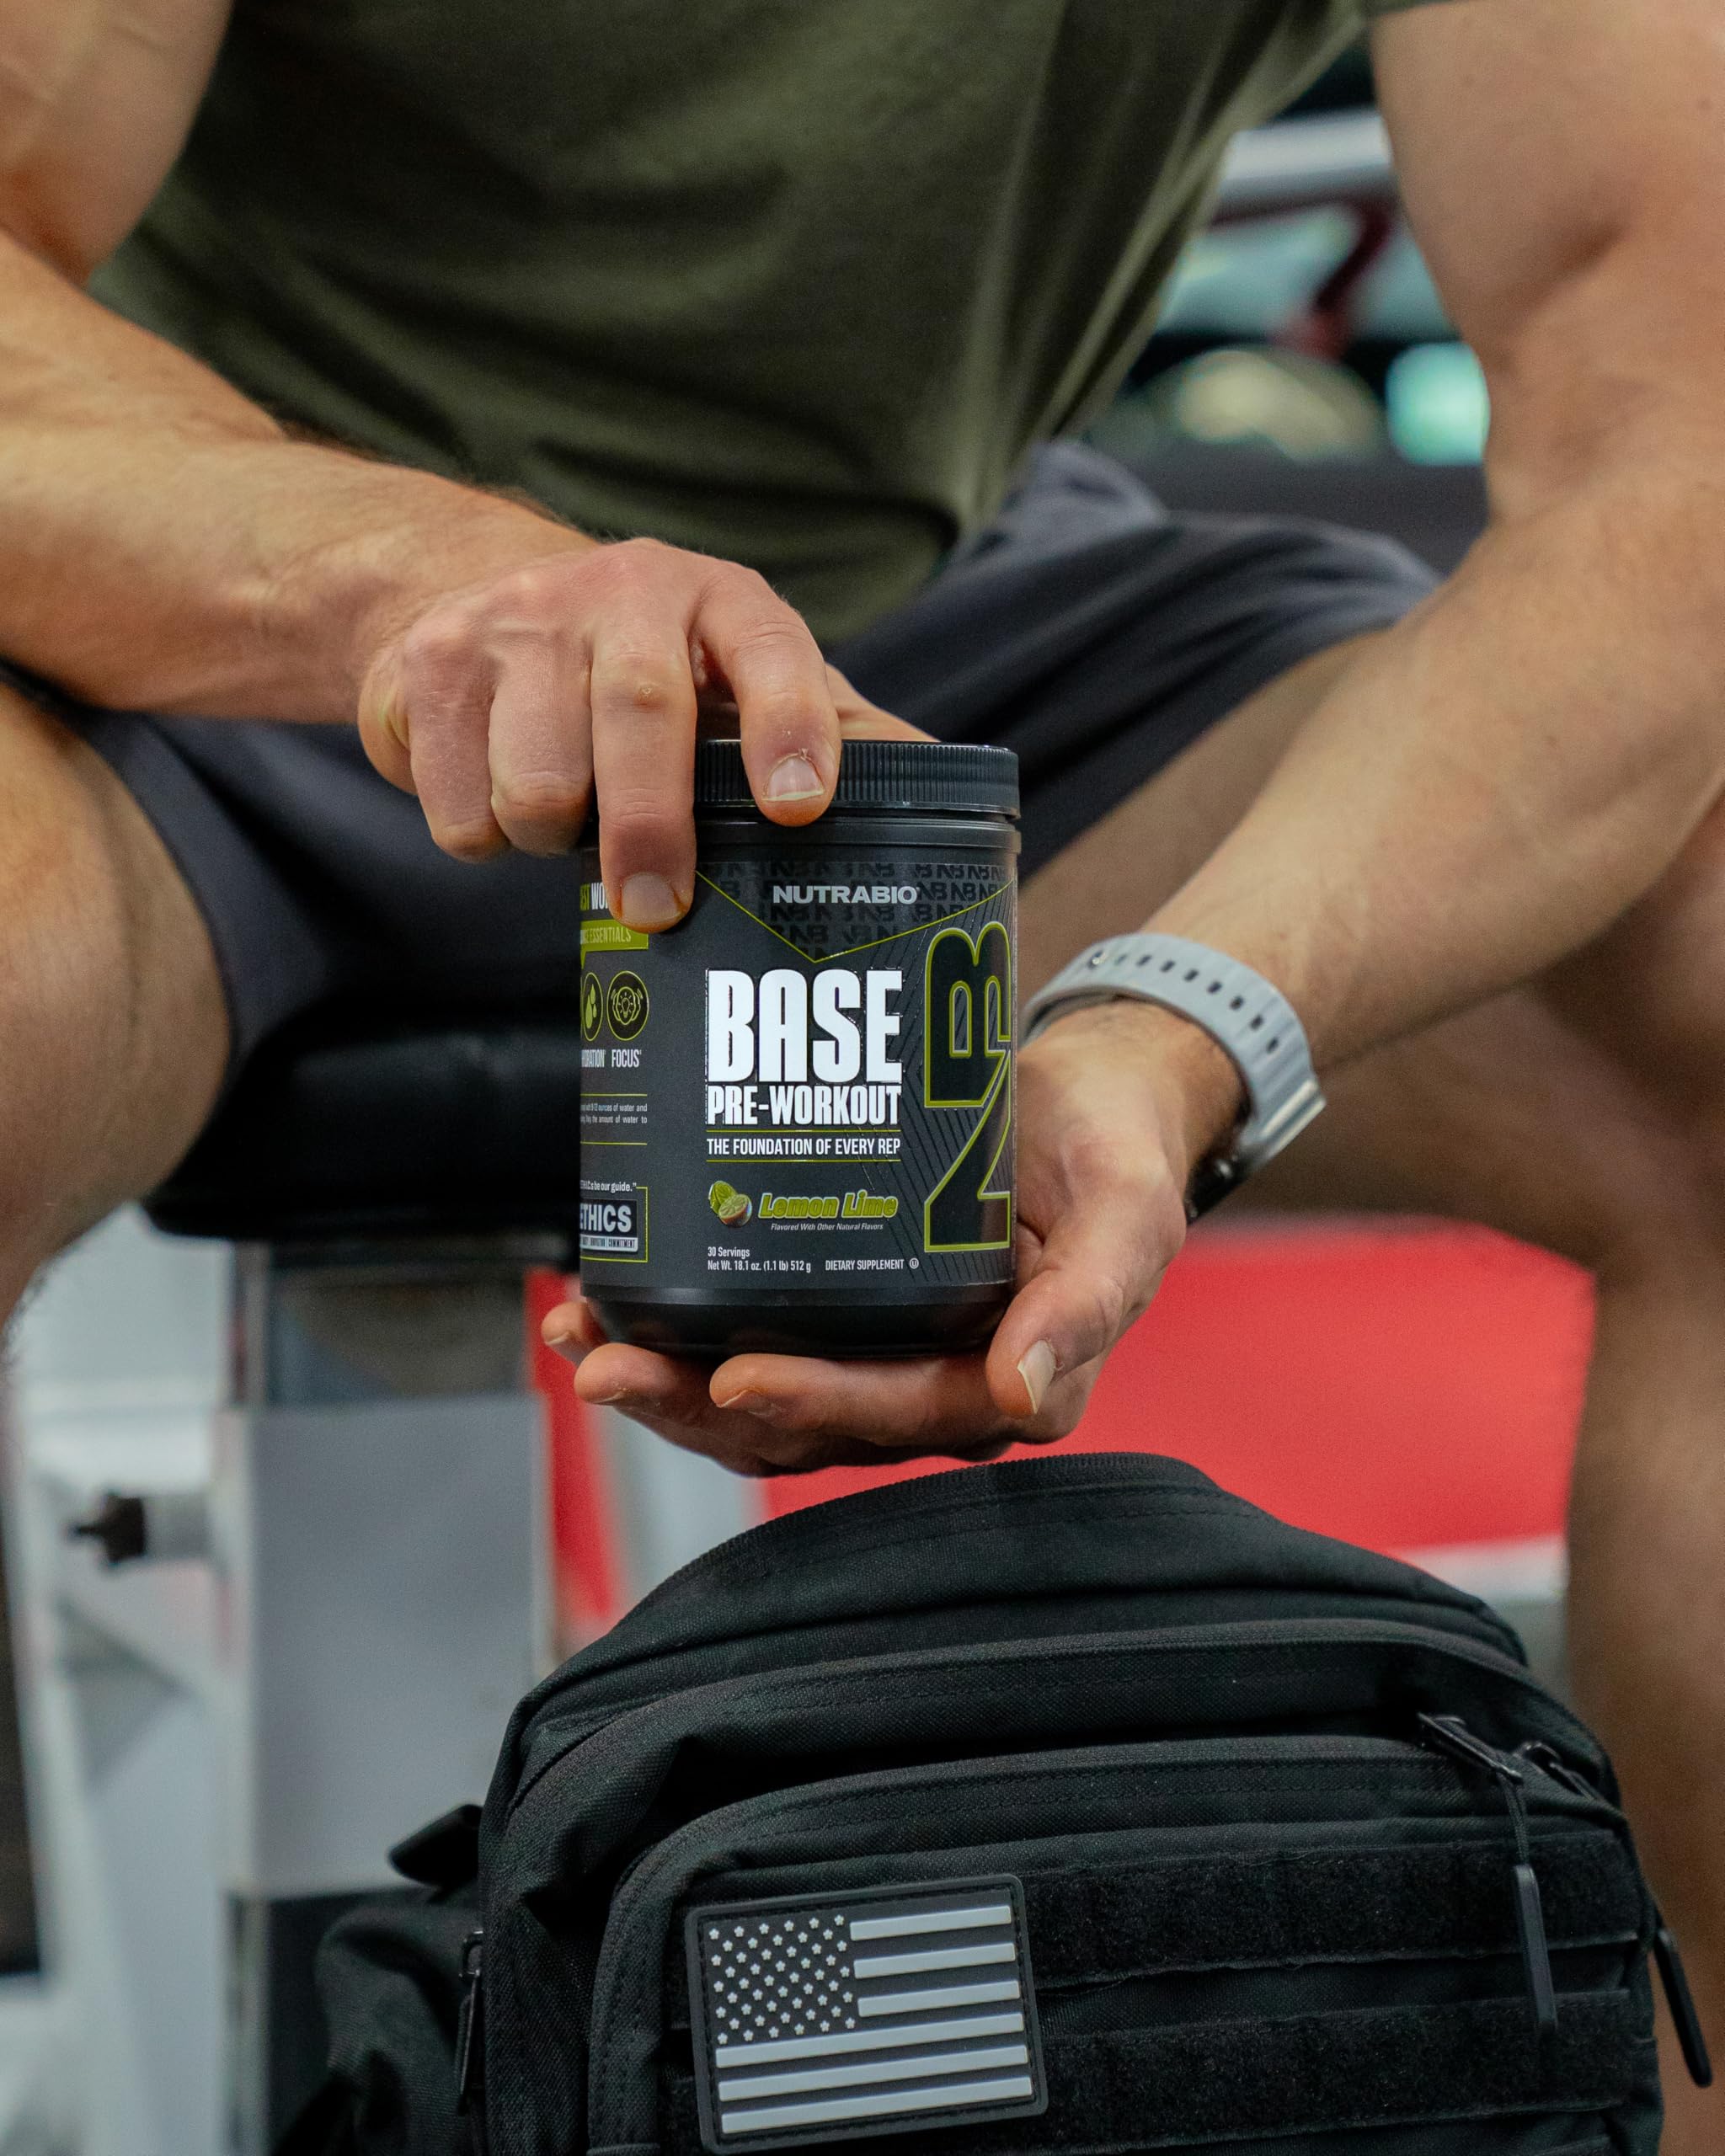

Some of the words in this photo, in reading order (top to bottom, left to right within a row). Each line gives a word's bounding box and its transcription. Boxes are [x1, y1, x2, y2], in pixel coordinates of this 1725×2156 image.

[773, 885, 918, 905] NUTRABIO
[707, 969, 902, 1083] BASE
[613, 1102, 619, 1112] of
[636, 1103, 648, 1112] and
[707, 1085, 902, 1125] PRE-WORKOUT
[615, 1115, 621, 1123] of
[707, 1138, 729, 1155] THE
[733, 1138, 812, 1155] FOUNDATION
[816, 1138, 832, 1155] OF
[836, 1138, 874, 1155] EVERY
[878, 1138, 901, 1155] REP
[601, 1182, 611, 1191] our
[758, 1193, 840, 1219] Lemon
[841, 1189, 899, 1219] Lime
[771, 1223, 799, 1231] Flavored
[800, 1223, 816, 1231] With
[817, 1223, 835, 1231] Other
[836, 1223, 861, 1231] Natural
[708, 1246, 717, 1257] 30
[718, 1246, 750, 1260] Servings
[708, 1260, 720, 1271] Net
[721, 1260, 732, 1271] Wt.
[734, 1260, 749, 1271] 18.1
[750, 1262, 762, 1271] oz.
[763, 1260, 777, 1272] (1.1
[778, 1260, 789, 1272] lb)
[790, 1260, 804, 1271] 512
[806, 1262, 812, 1273] g
[825, 1260, 855, 1271] DIETARY
[857, 1259, 905, 1270] SUPPLEMENT
